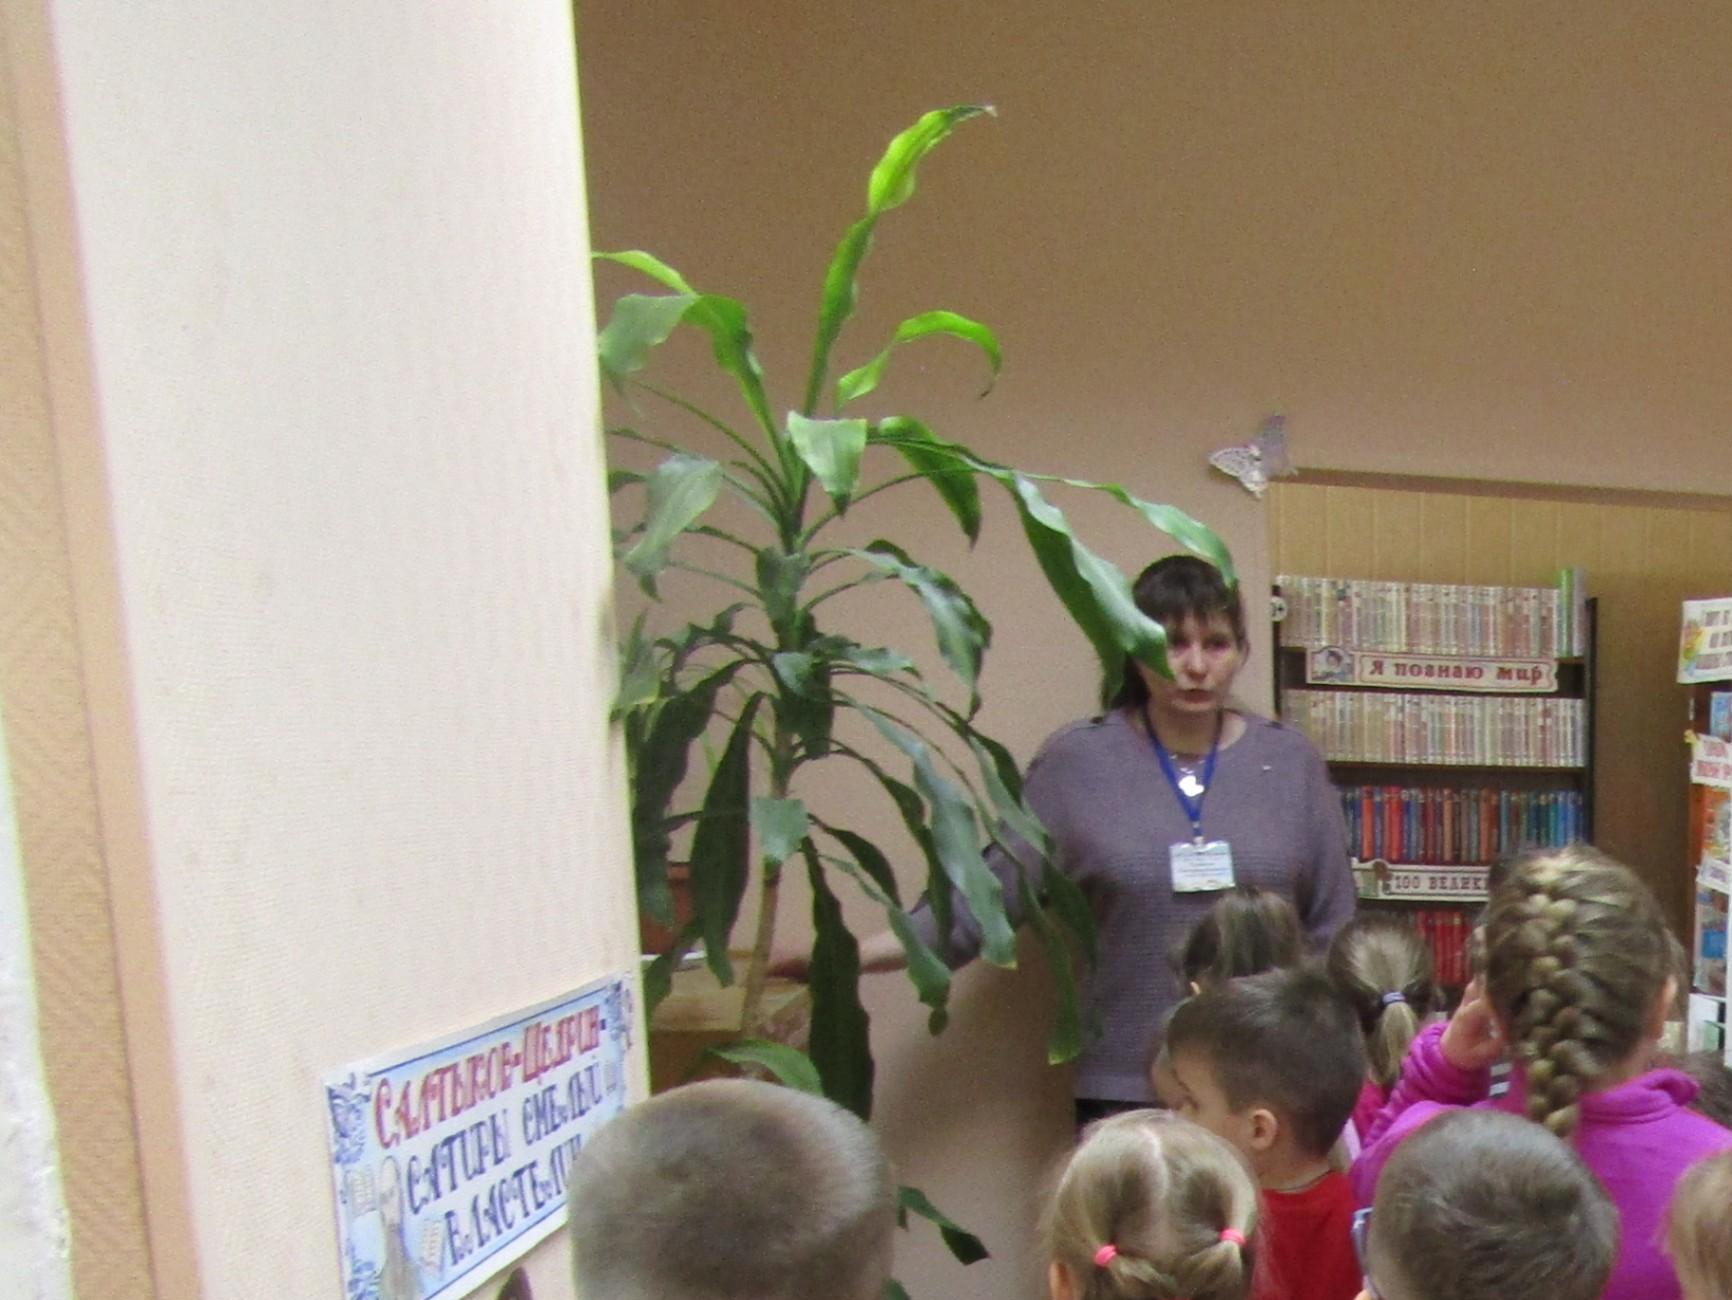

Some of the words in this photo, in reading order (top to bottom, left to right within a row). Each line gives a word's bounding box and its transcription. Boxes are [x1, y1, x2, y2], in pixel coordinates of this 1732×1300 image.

[1369, 660, 1384, 675] Я
[1394, 662, 1484, 679] познаю
[1496, 665, 1543, 686] мир
[1395, 875, 1420, 889] 100
[1429, 876, 1488, 890] ВЕЛИК
